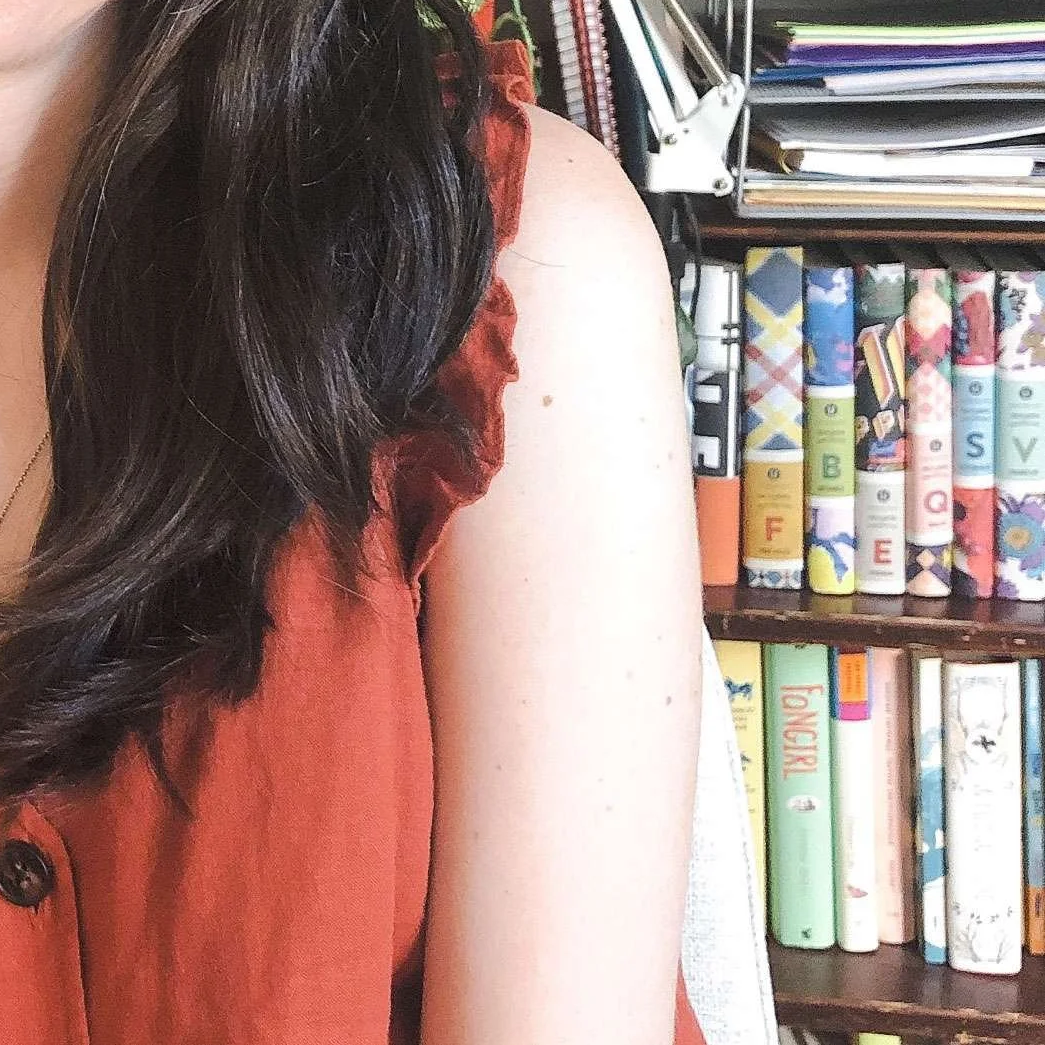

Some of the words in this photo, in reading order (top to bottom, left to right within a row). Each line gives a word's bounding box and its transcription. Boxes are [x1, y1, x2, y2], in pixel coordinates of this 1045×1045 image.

[966, 431, 985, 458] S
[1013, 436, 1038, 463] V
[822, 453, 841, 478] B
[923, 490, 948, 514] Q
[764, 515, 784, 542] F
[873, 539, 893, 565] E
